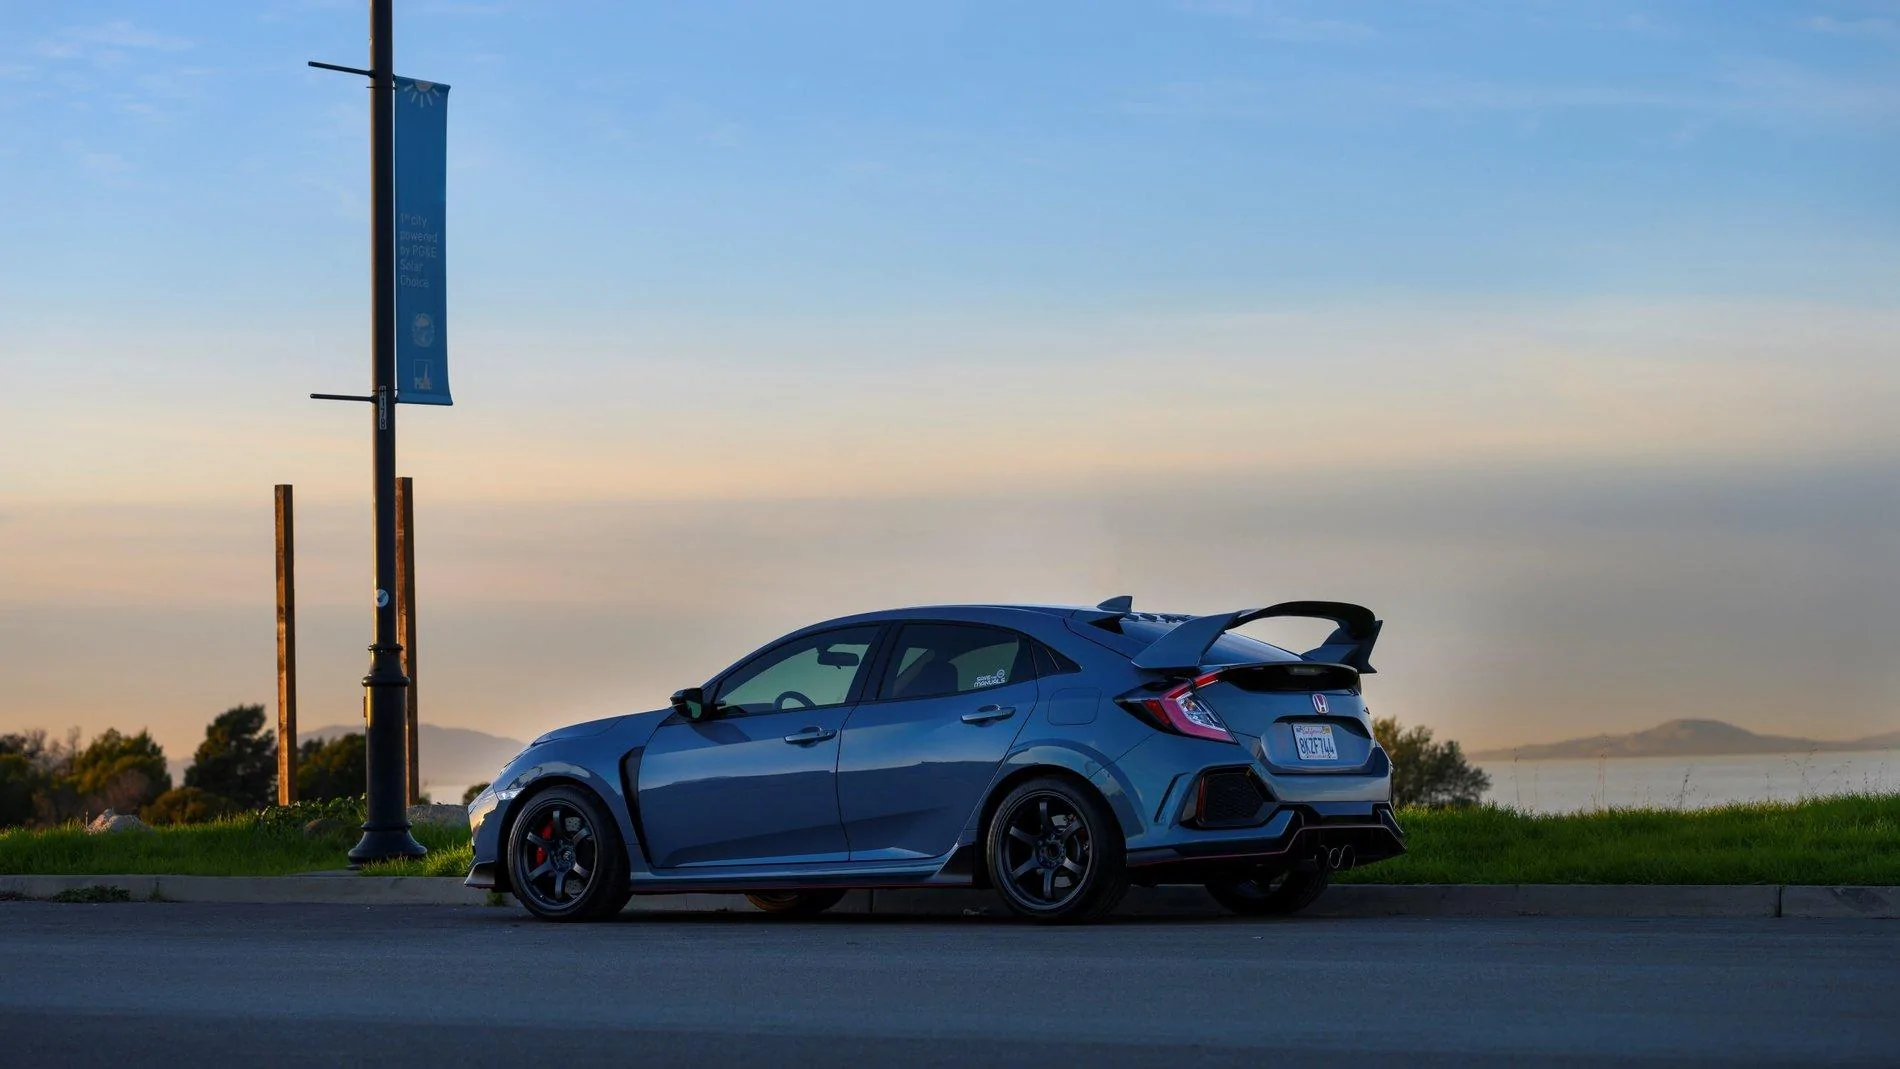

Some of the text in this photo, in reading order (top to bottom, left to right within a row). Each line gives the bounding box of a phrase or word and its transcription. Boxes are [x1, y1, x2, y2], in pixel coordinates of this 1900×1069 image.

[400, 231, 439, 245] powered
[400, 246, 410, 259] by
[400, 258, 425, 272] Solar
[400, 274, 430, 288] Choice
[1299, 738, 1334, 754] 8KZF744
